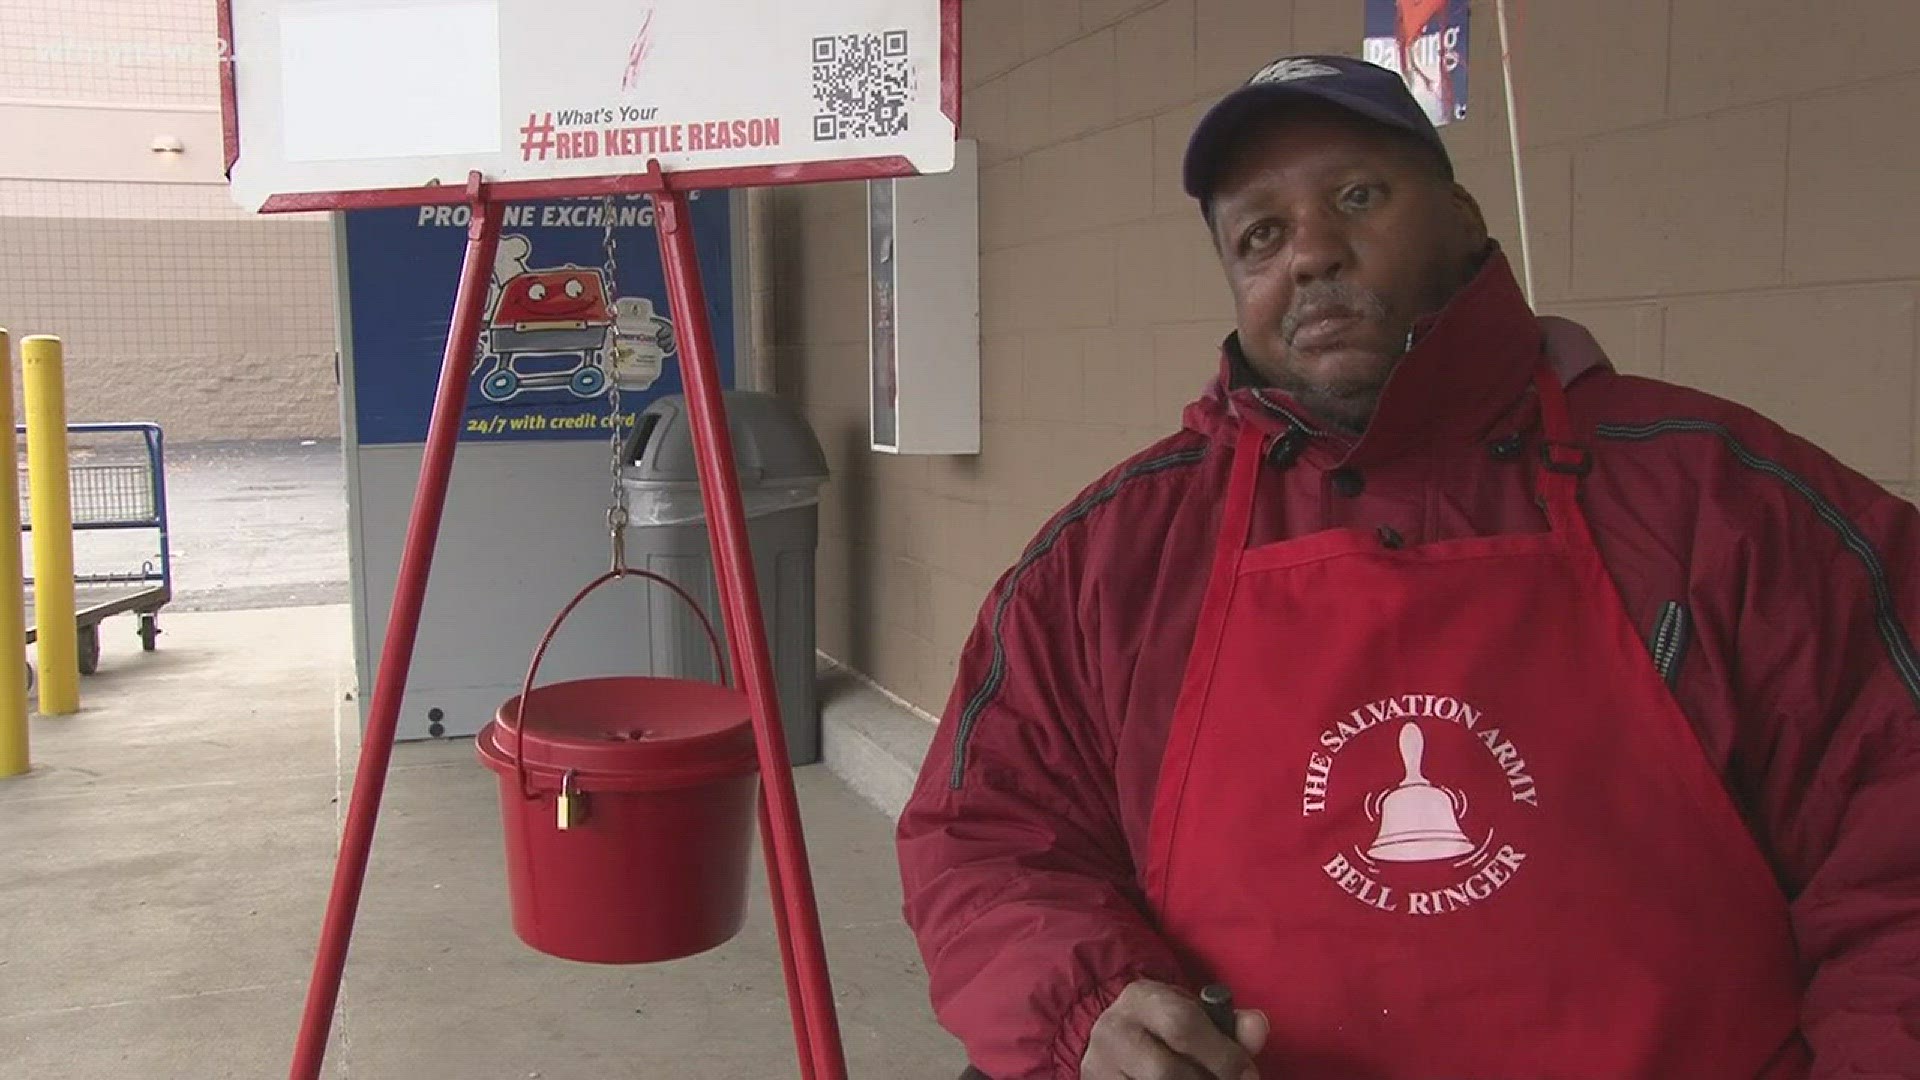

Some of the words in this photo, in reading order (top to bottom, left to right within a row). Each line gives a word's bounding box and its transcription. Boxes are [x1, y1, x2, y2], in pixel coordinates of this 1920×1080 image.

[556, 107, 613, 126] What's
[619, 105, 659, 122] Your
[605, 125, 683, 157] KETTLE
[688, 117, 780, 151] REASON
[418, 205, 536, 227] PRONE
[541, 204, 657, 227] EXCHANG
[466, 415, 507, 434] 24/7
[510, 415, 546, 431] with
[550, 413, 598, 429] credit
[1303, 751, 1333, 816] THE
[1320, 694, 1481, 753] SALVATION
[1477, 728, 1538, 807] ARMY
[1322, 853, 1397, 911] BELL
[1408, 844, 1527, 915] RINGER
